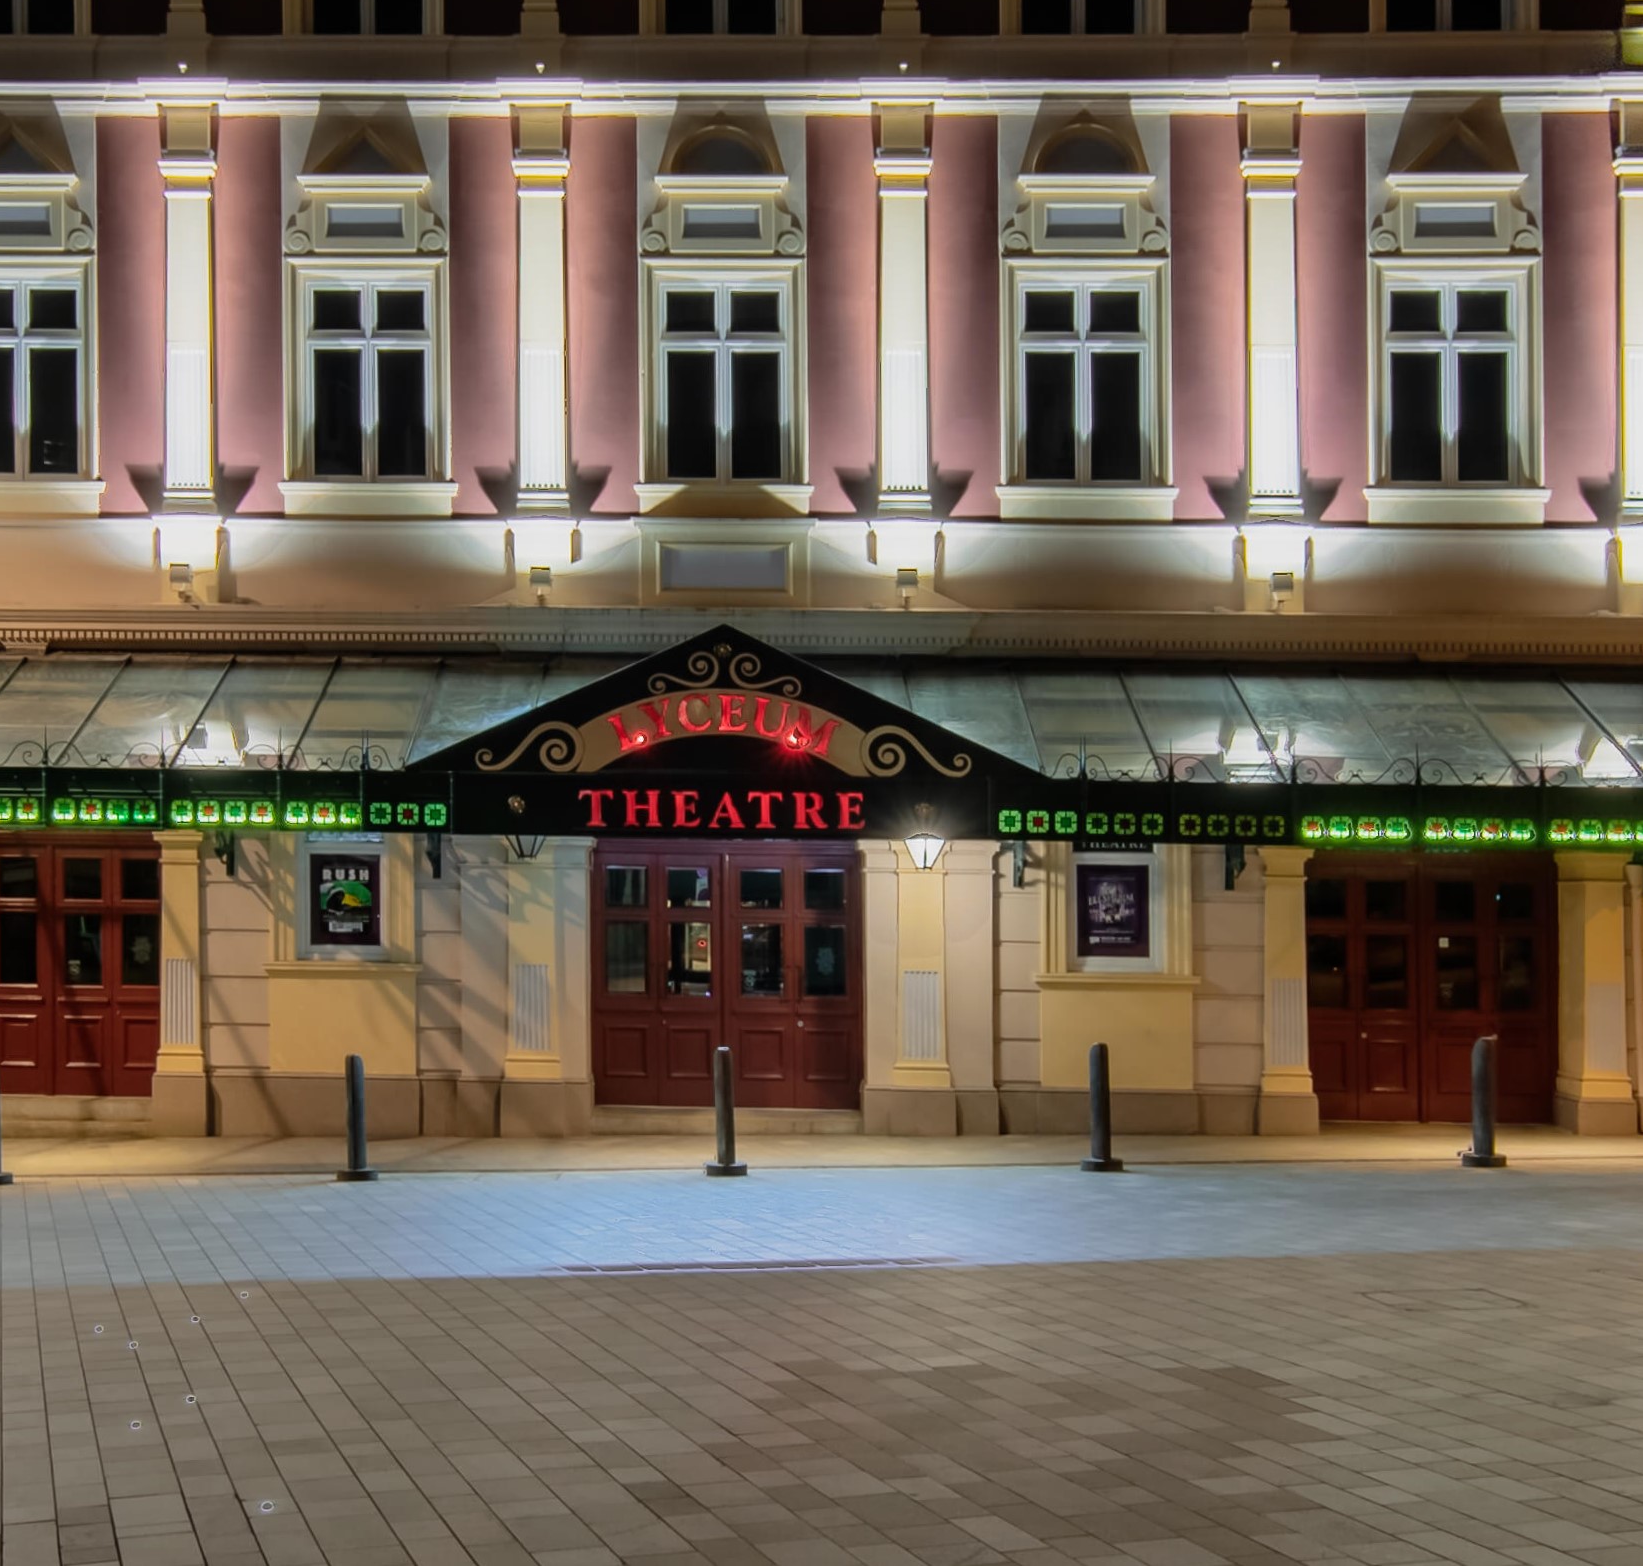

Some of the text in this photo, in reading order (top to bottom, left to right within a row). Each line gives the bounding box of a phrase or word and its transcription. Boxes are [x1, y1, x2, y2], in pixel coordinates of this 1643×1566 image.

[608, 693, 841, 756] LYCEUM
[578, 789, 867, 830] THEATRE
[321, 868, 370, 881] RUSH
